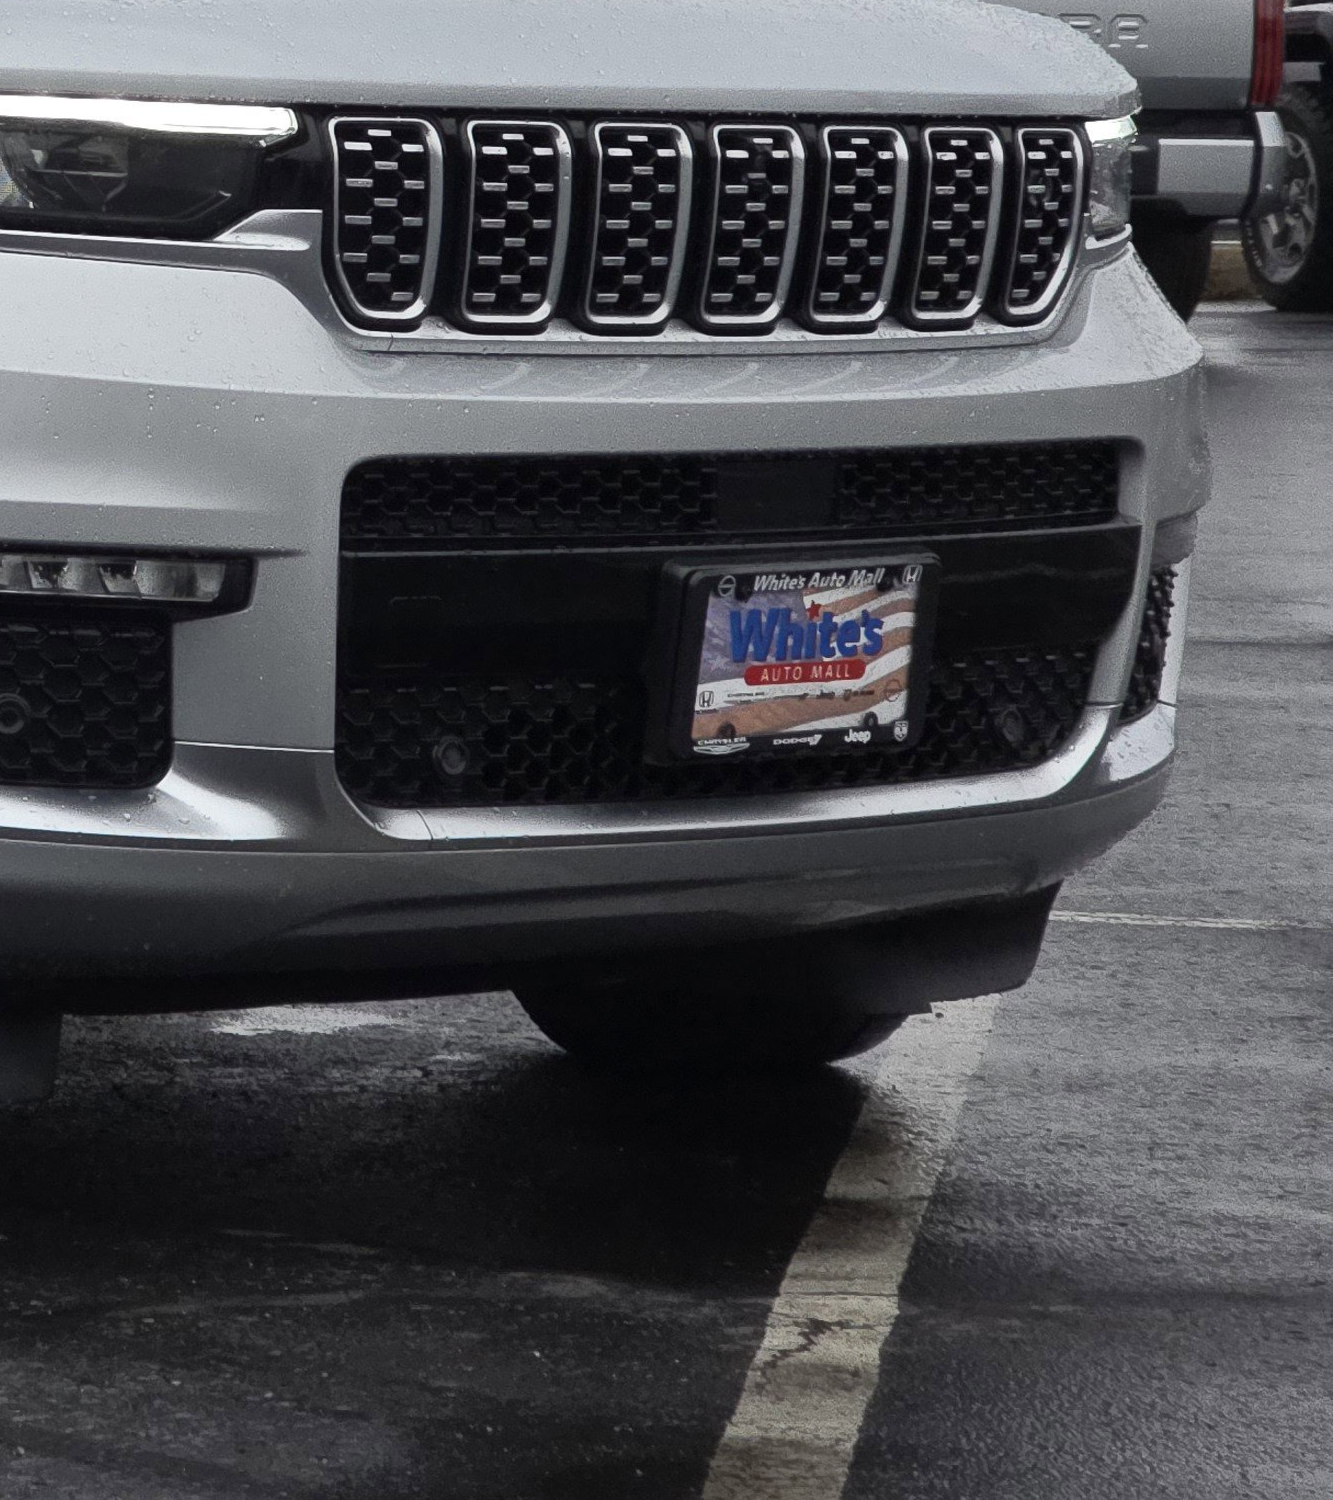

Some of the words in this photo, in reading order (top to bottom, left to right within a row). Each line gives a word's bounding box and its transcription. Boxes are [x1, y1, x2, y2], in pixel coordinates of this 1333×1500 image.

[754, 574, 807, 592] White's
[808, 571, 846, 589] Auto
[848, 567, 886, 585] Mall
[729, 607, 885, 663] White's
[760, 666, 802, 682] AUTO
[811, 663, 850, 679] MALL
[844, 729, 872, 744] Jeep
